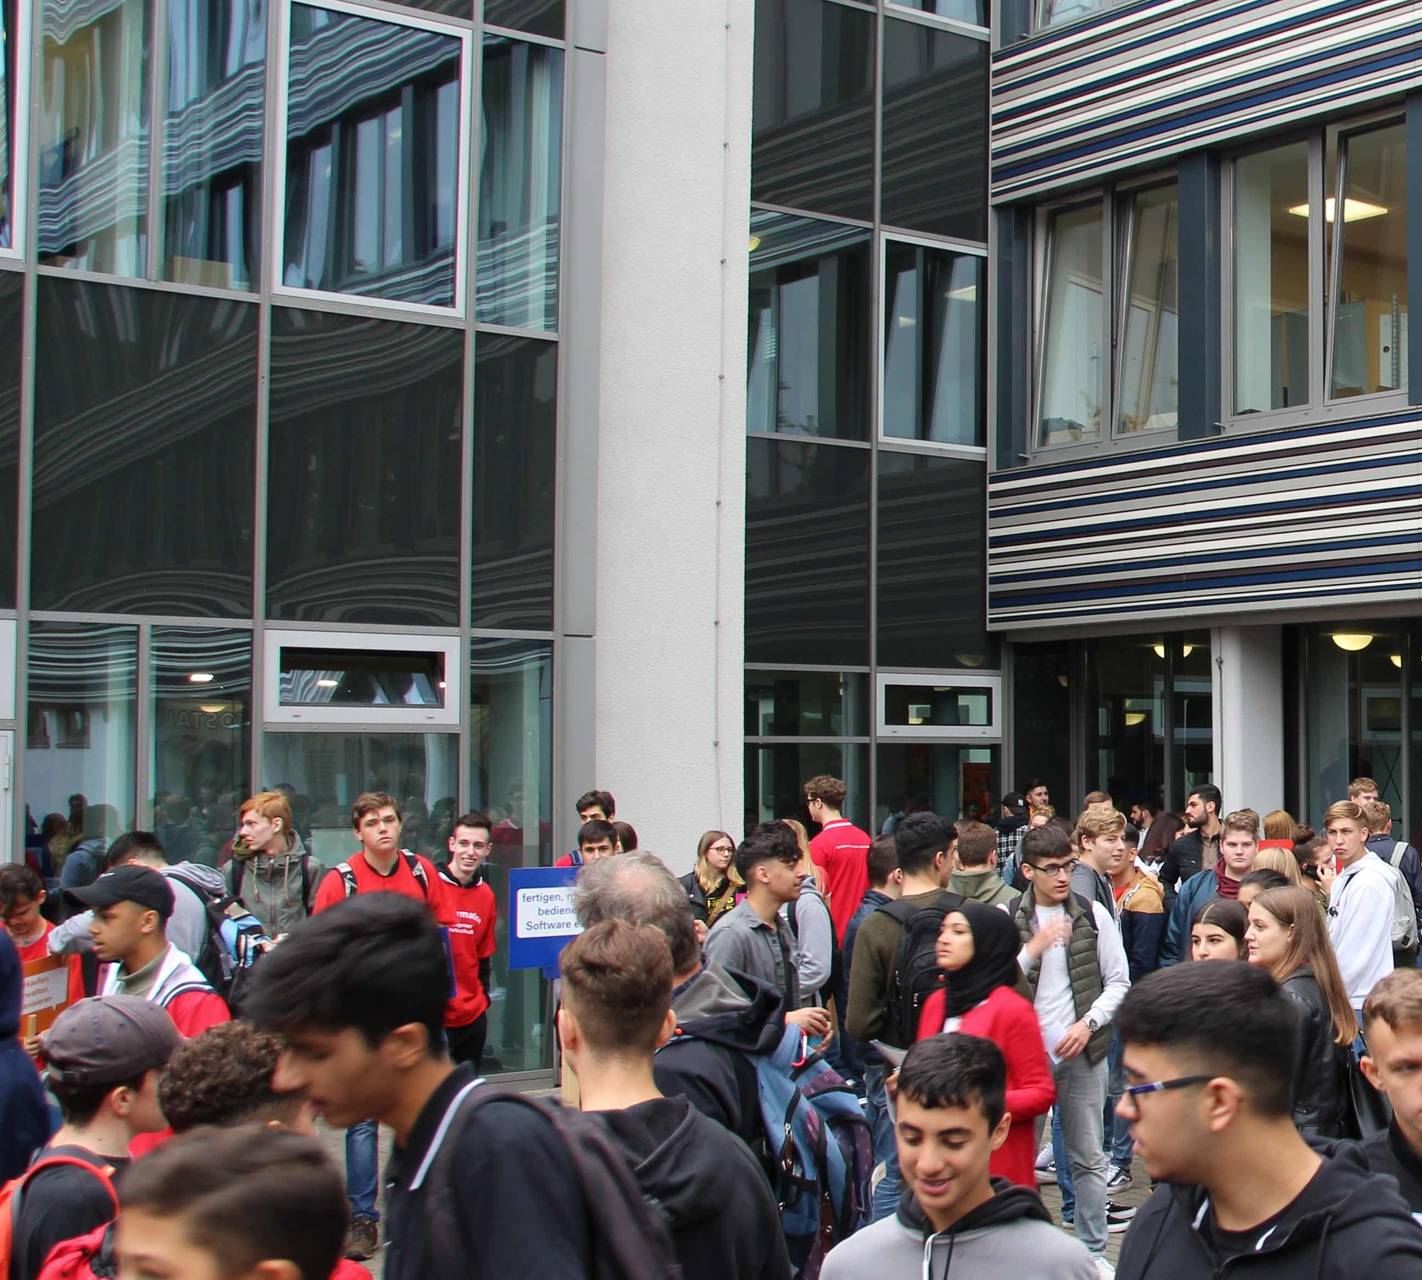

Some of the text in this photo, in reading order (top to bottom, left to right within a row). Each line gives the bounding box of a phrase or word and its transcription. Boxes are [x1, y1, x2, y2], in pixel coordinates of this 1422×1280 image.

[522, 892, 564, 904] fertigen,
[538, 905, 577, 917] bediene
[525, 919, 572, 931] Software
